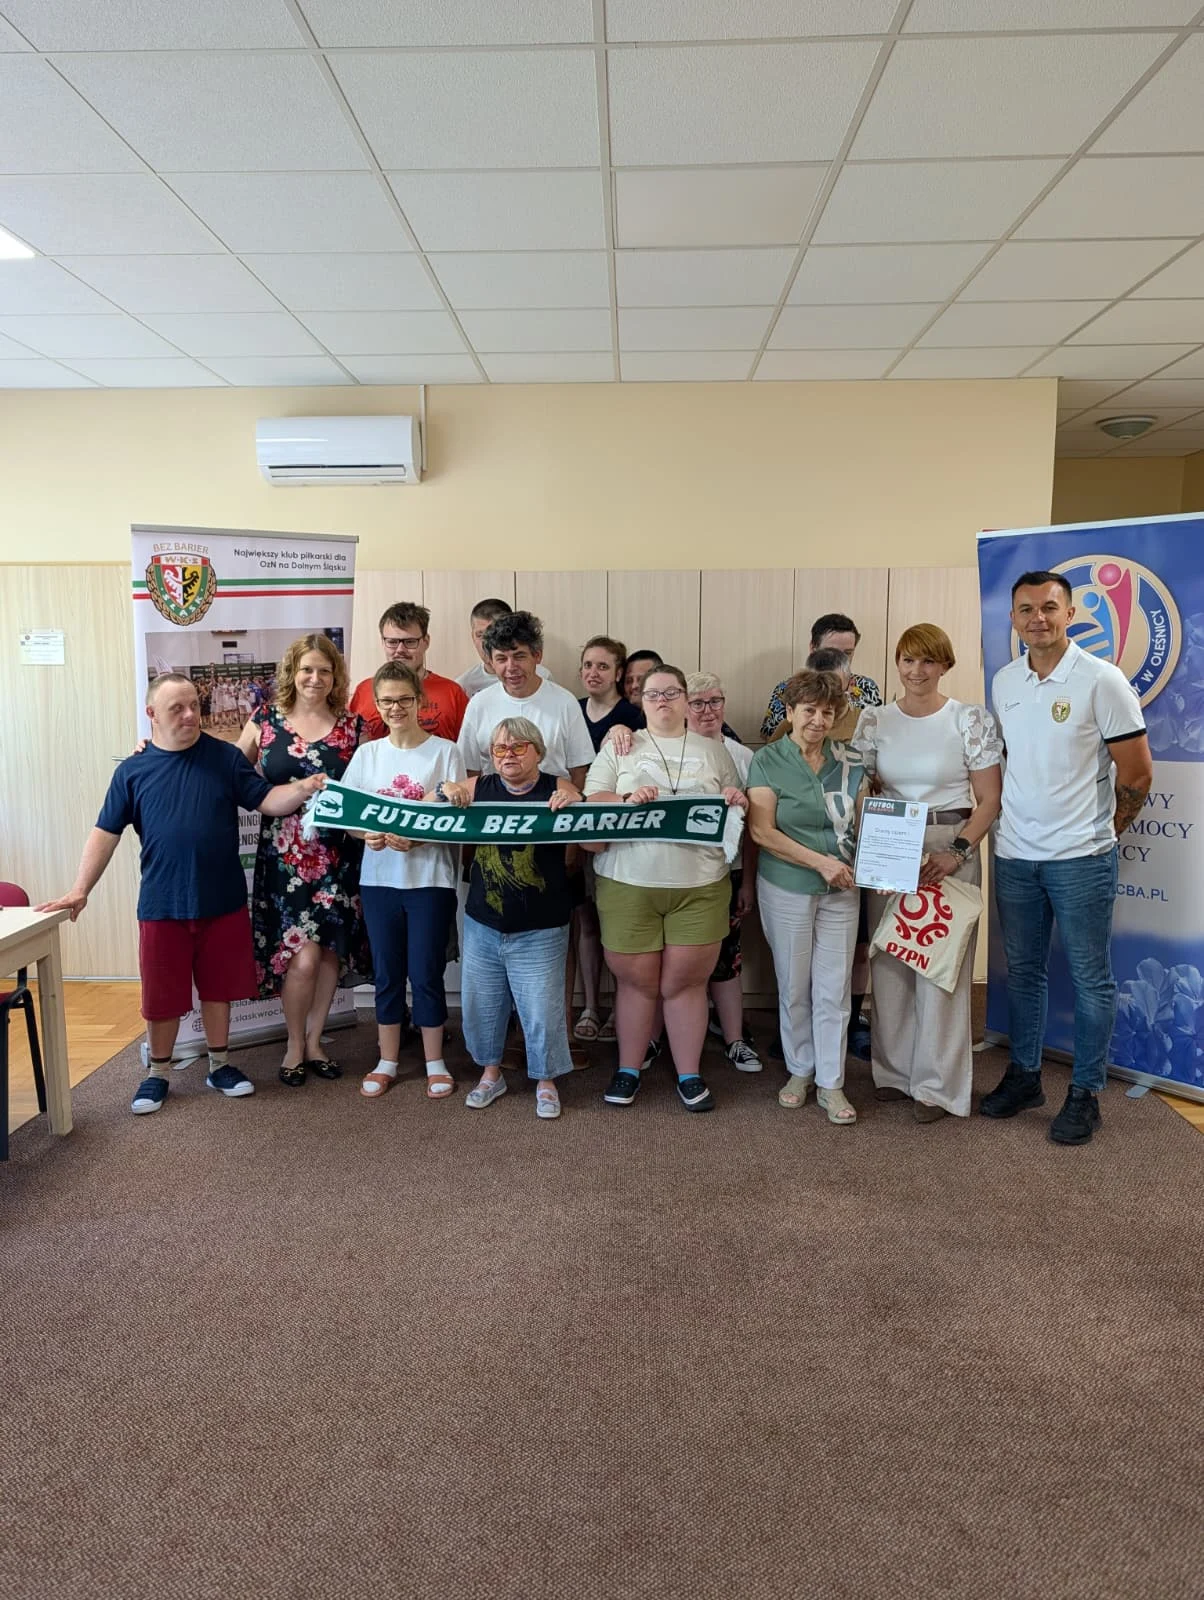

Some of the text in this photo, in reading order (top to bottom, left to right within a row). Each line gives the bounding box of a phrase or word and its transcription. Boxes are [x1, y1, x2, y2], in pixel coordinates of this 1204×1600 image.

[153, 542, 209, 554] BEZ BARIER
[234, 549, 279, 558] Największy
[281, 550, 298, 559] klub
[334, 553, 347, 561] dla
[260, 560, 276, 568] OzN
[291, 561, 321, 571] Dolnym
[323, 563, 347, 572] Śląsku
[1140, 669, 1154, 682] W
[1150, 609, 1167, 666] OLEŚNICY
[868, 801, 895, 809] FUTBOL
[1143, 792, 1174, 809] WY
[360, 803, 666, 834] FUTBOL BEZ BARIER
[1128, 820, 1194, 839] MOCY
[240, 832, 260, 846] NOS
[1116, 883, 1169, 902] CBA.PL
[886, 942, 930, 970] PZPN
